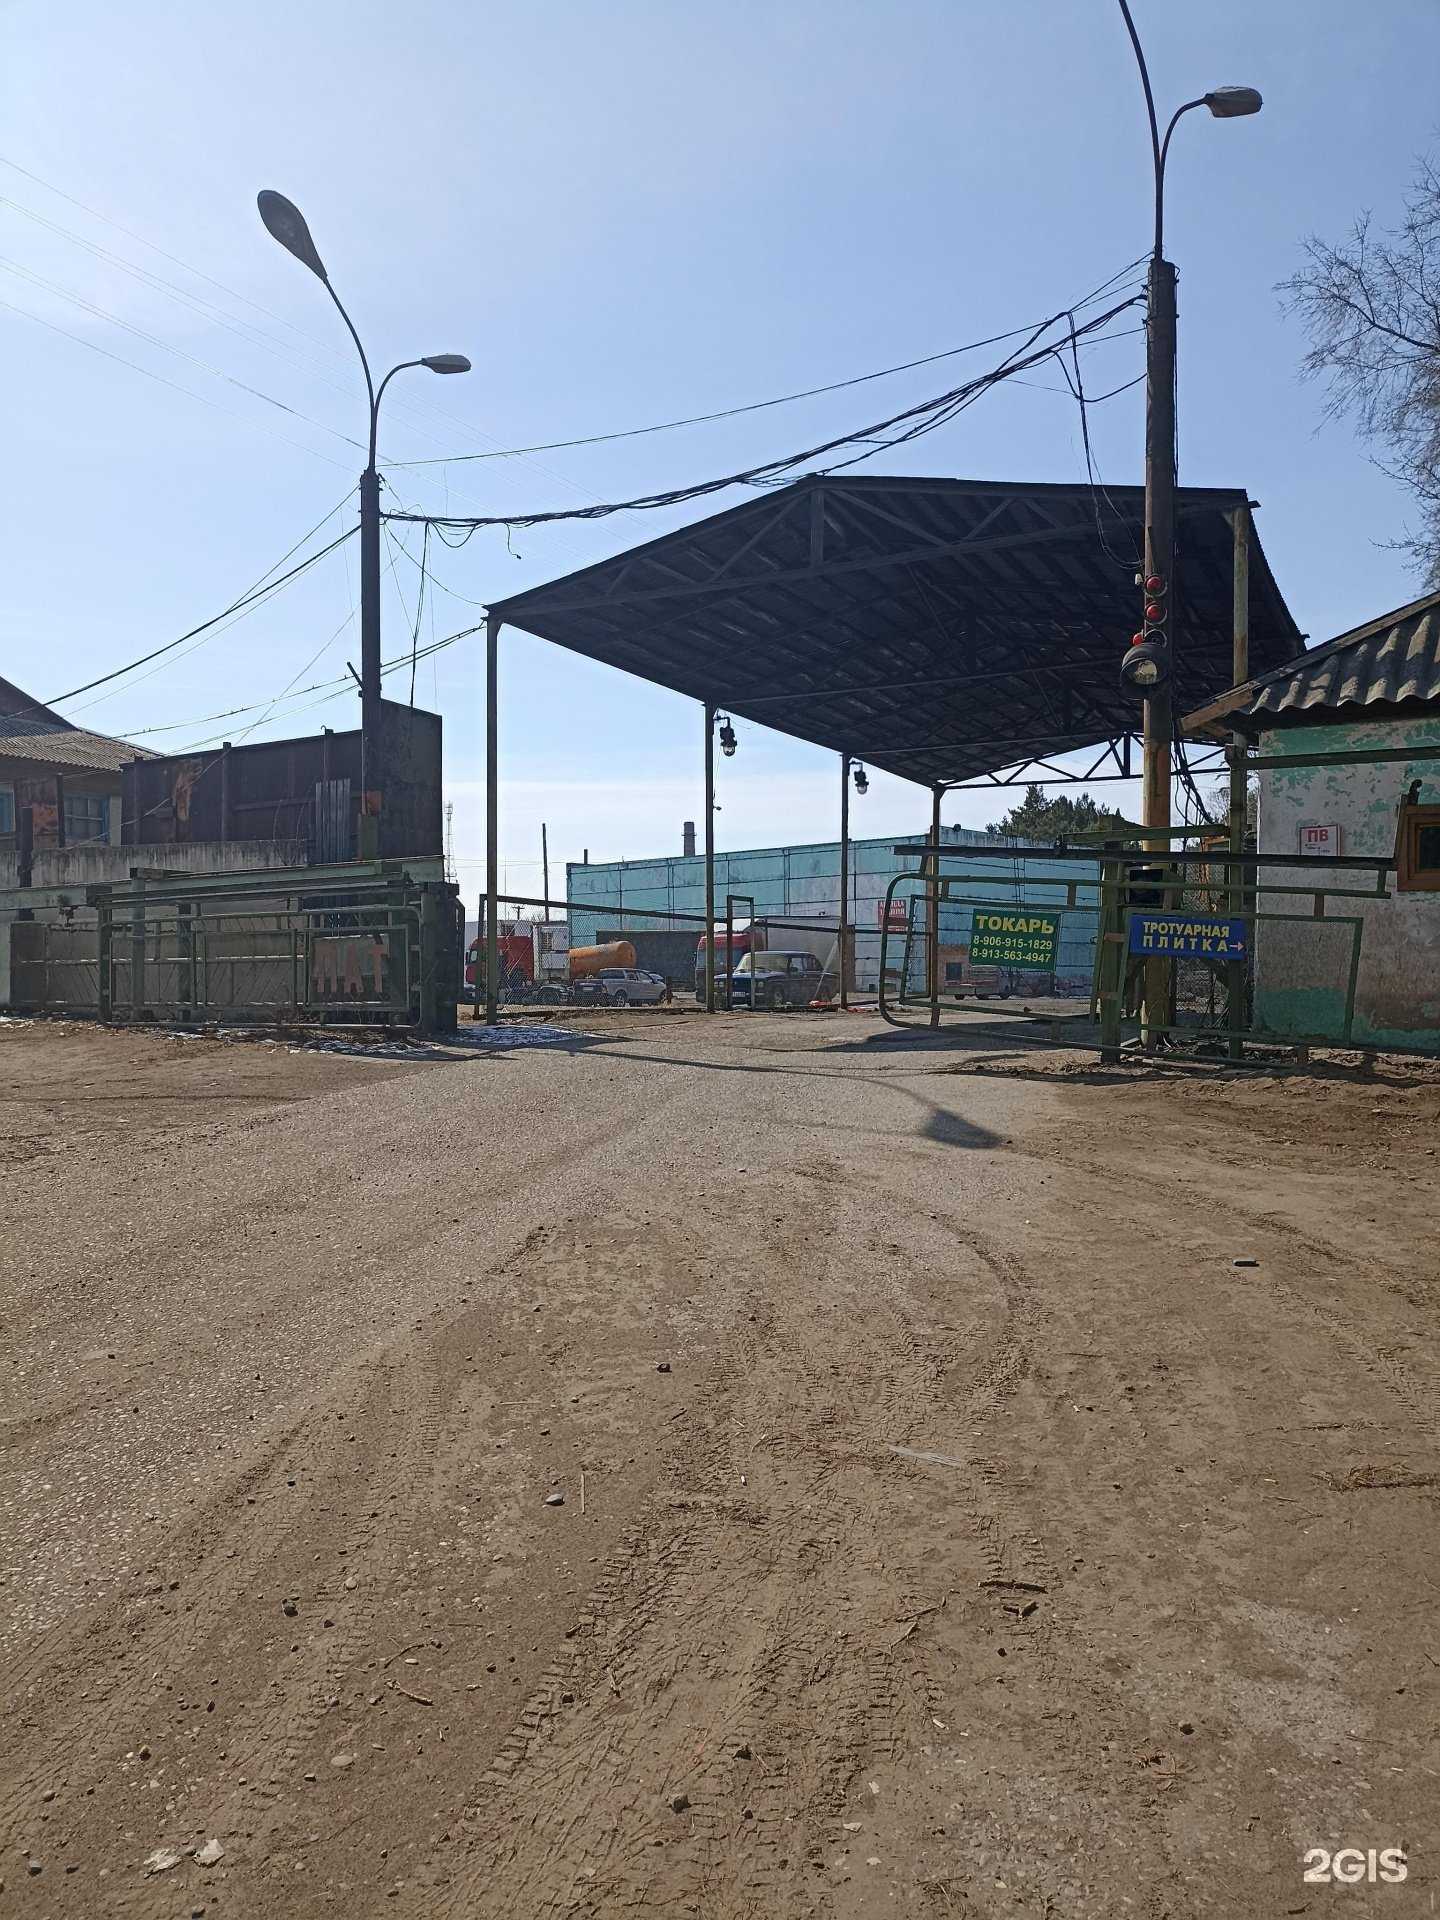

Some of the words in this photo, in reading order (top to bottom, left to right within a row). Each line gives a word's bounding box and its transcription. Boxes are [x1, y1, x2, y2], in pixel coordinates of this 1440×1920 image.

[975, 915, 1054, 934] ТОКАРЬ
[1143, 921, 1230, 938] ТРОТУАРНАЯ
[973, 935, 1053, 950] 8-906-915-1829
[1143, 935, 1228, 952] ПЛИТКА
[972, 947, 1052, 962] 8-913-563-4947
